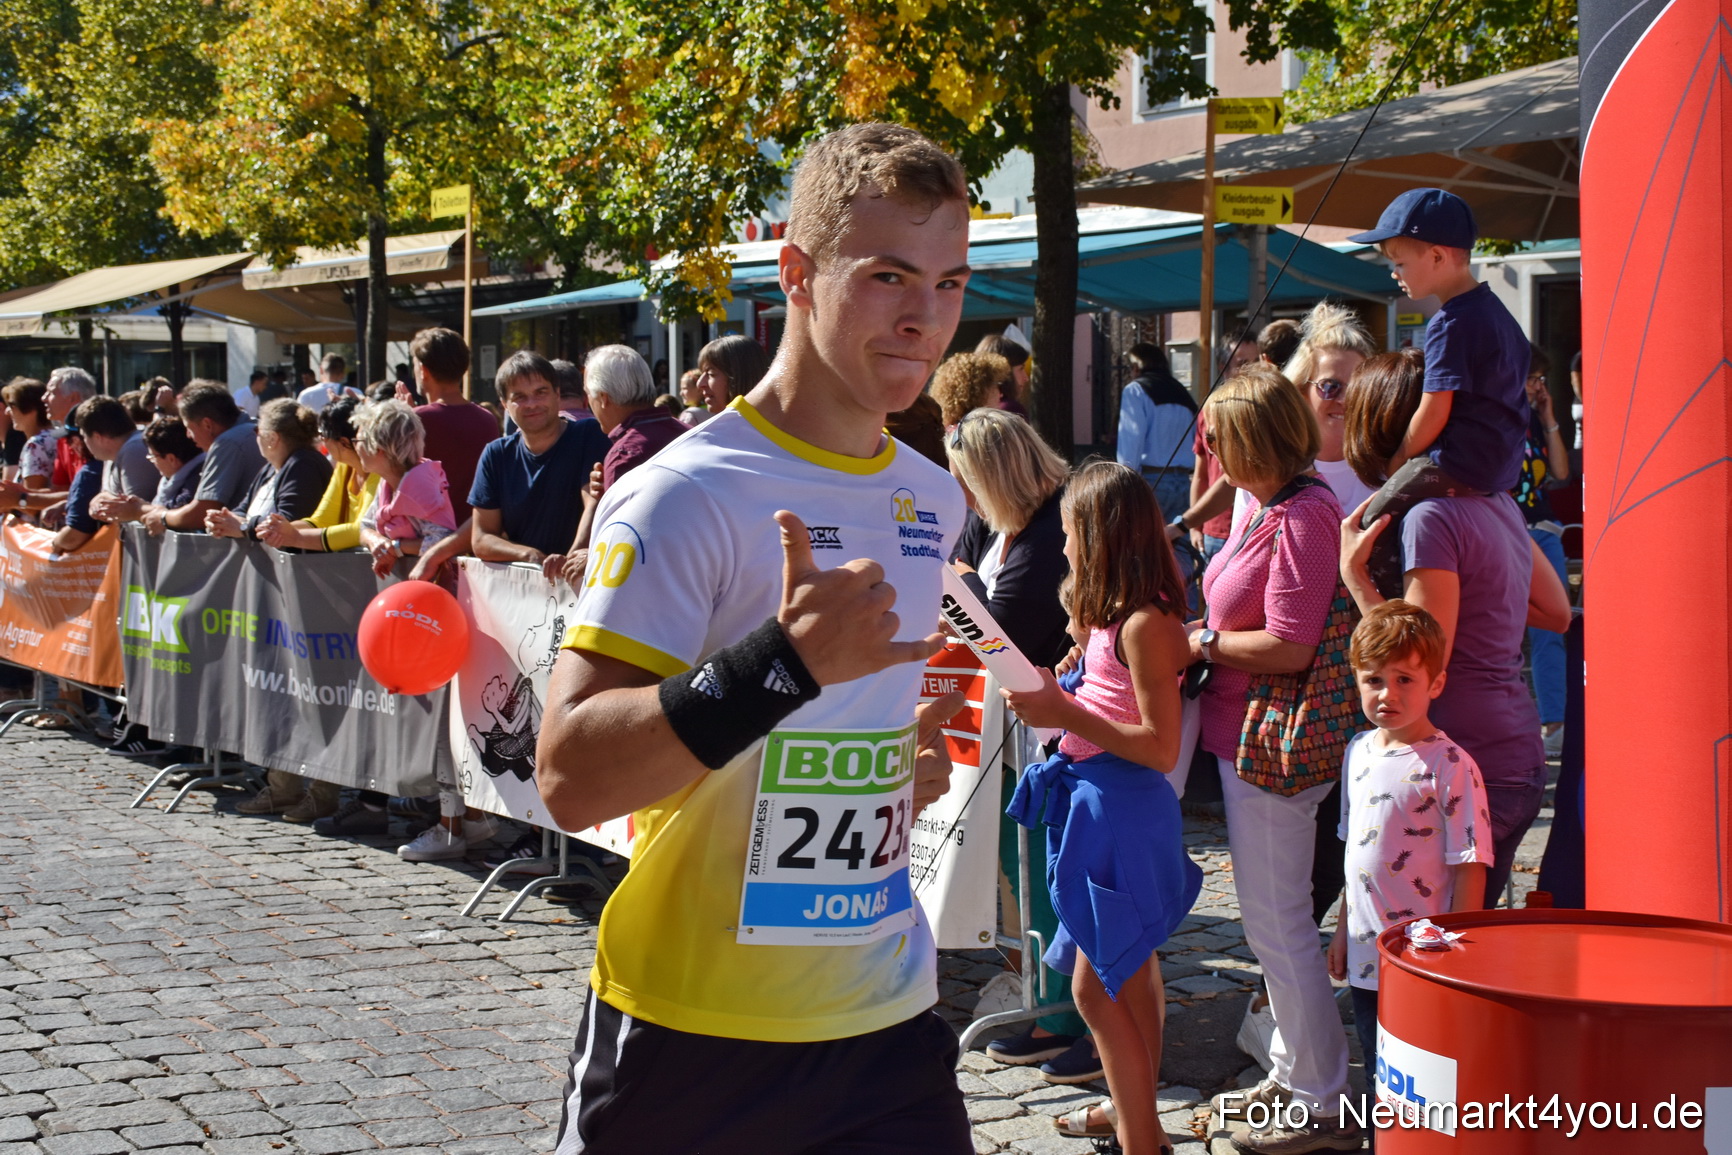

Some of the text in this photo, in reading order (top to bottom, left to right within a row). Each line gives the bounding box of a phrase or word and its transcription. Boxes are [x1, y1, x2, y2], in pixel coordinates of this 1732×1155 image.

[1216, 104, 1271, 115] tartnummern-
[1224, 118, 1258, 132] ausgabe
[438, 195, 467, 209] Toiletten
[1222, 193, 1277, 205] Kleiderbeutel-
[1231, 206, 1265, 219] ausgabe
[895, 498, 917, 522] 20
[898, 525, 944, 544] Neumarkter
[586, 542, 636, 588] 20
[941, 593, 984, 641] swn
[4, 622, 45, 648] Agentur
[703, 662, 723, 700] adidas
[772, 658, 800, 696] adidas
[783, 741, 911, 781] BOCK
[776, 798, 907, 870] 2423
[803, 887, 889, 920] JONAS
